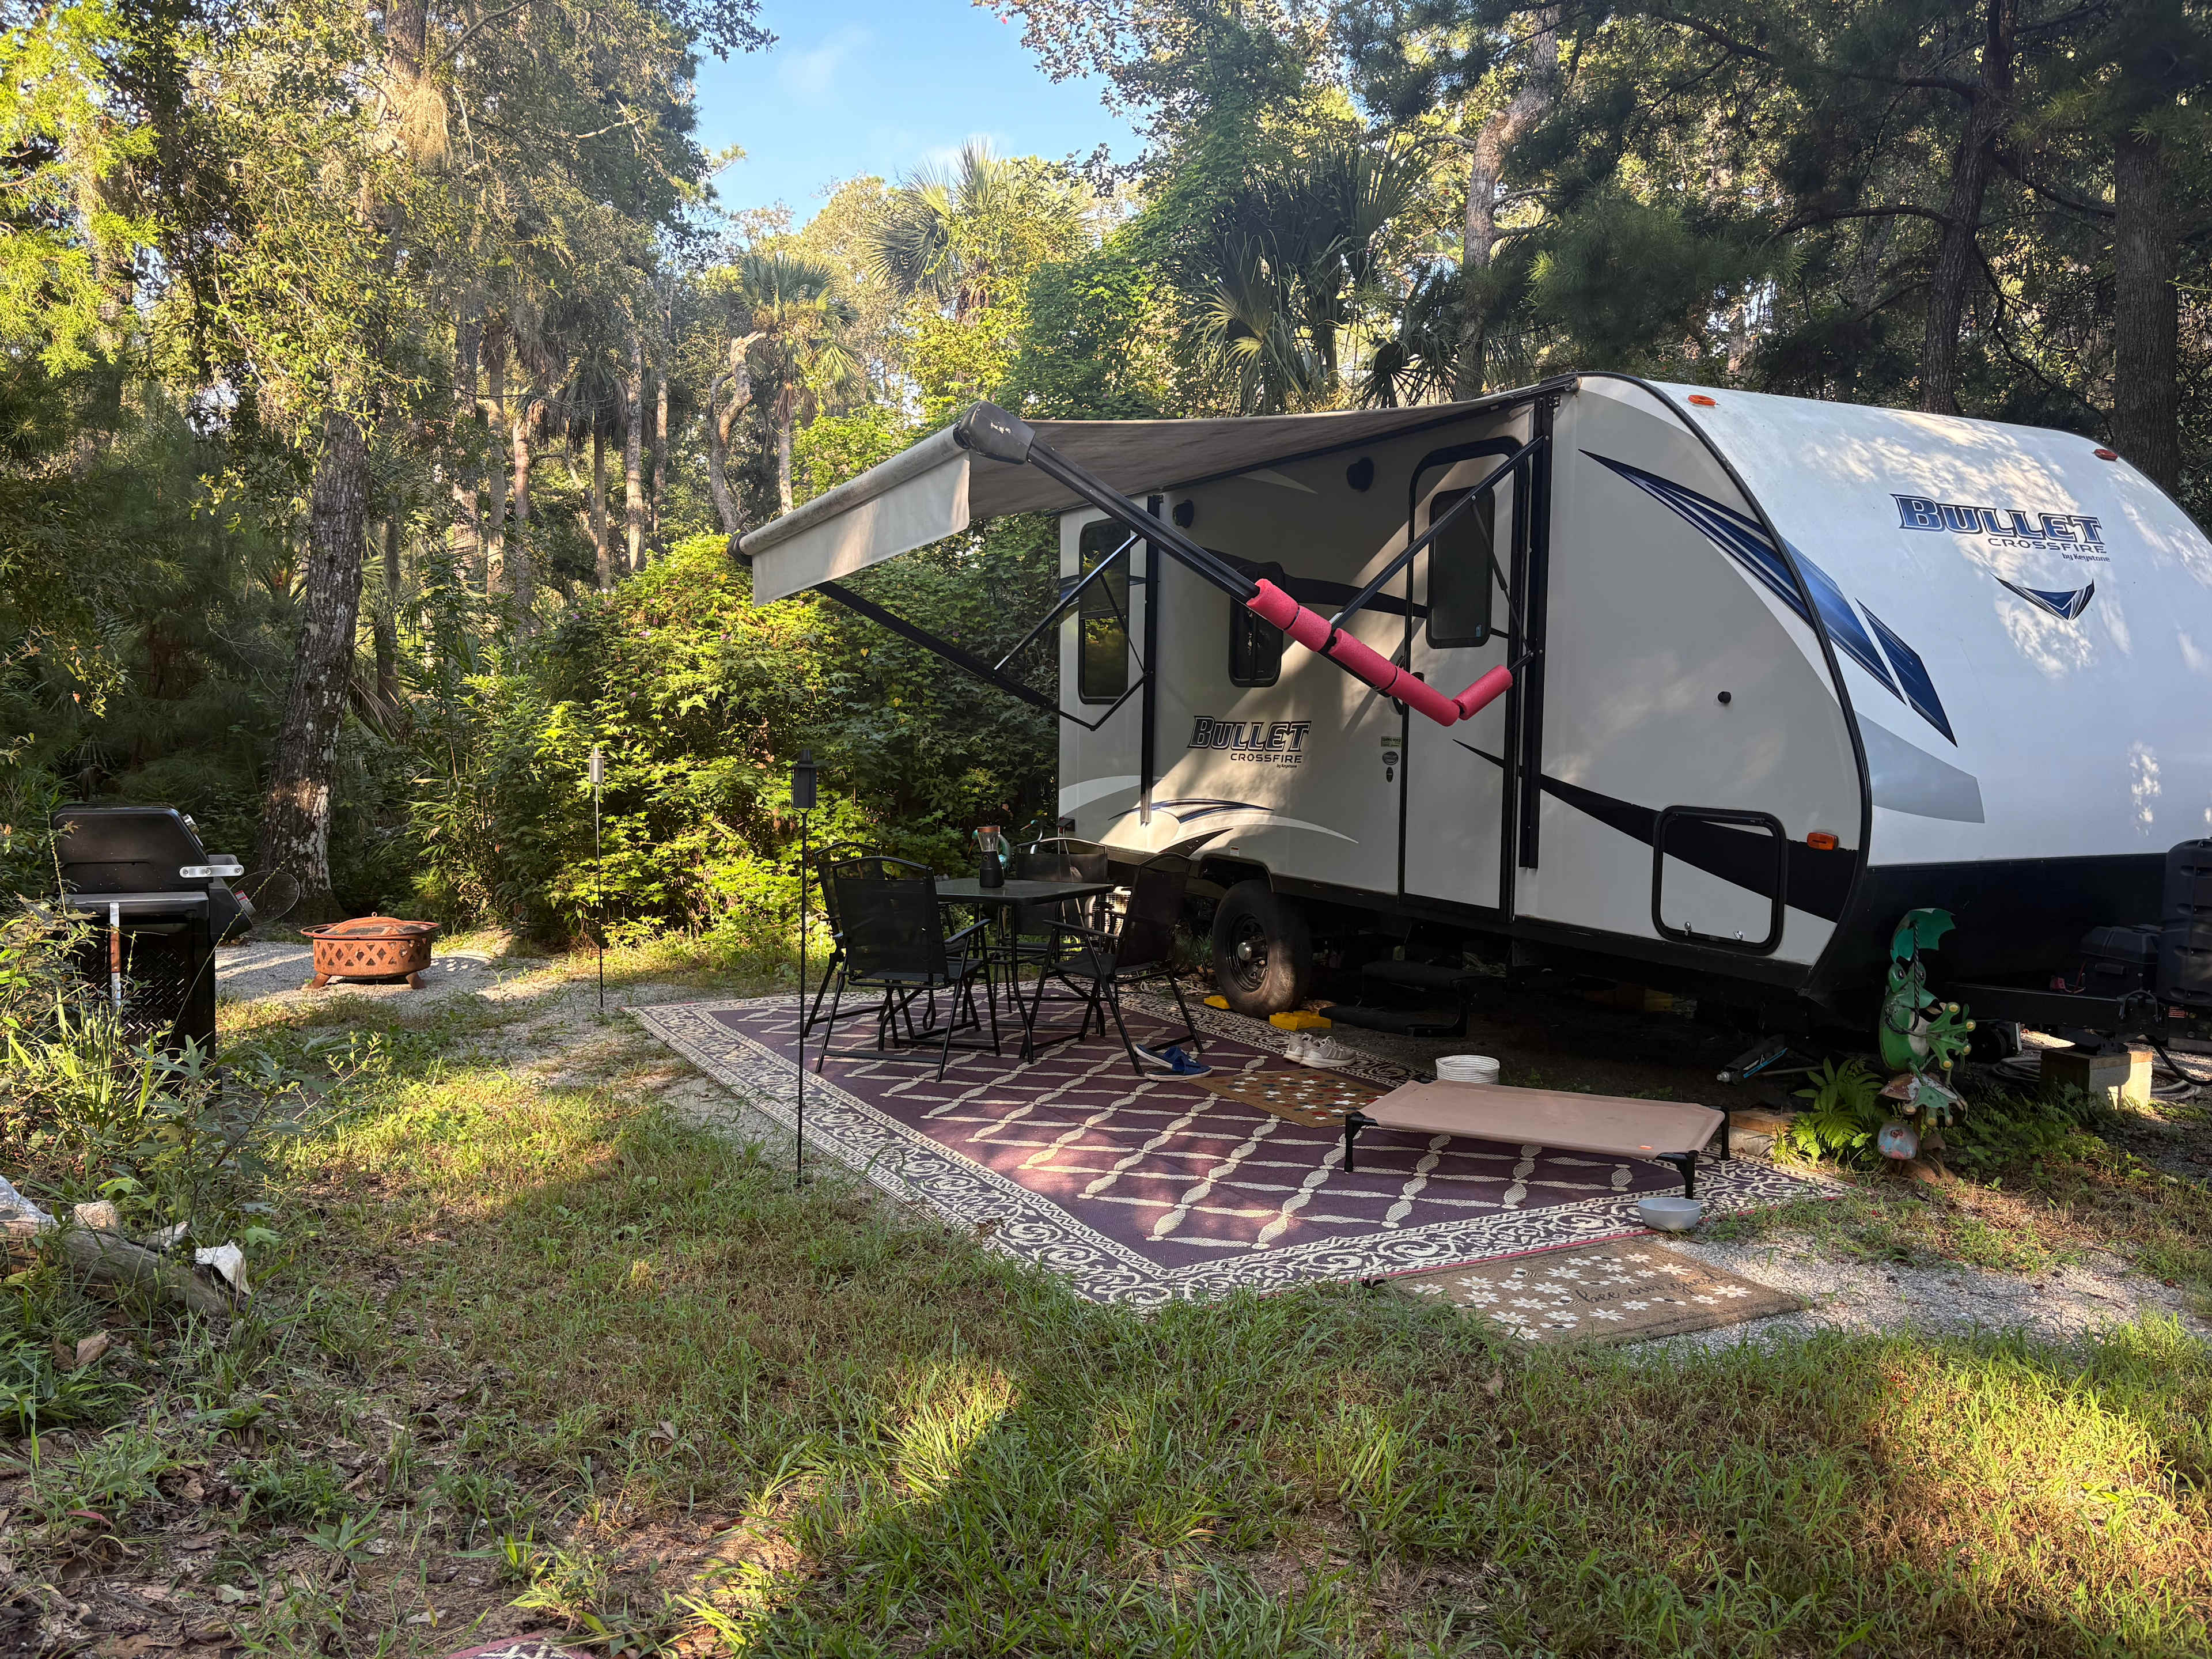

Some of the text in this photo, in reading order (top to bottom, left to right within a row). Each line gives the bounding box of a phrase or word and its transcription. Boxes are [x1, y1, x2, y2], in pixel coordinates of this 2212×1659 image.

[1889, 493, 2105, 545] BULLET
[1987, 538, 2107, 554] CROSSFIRE
[2062, 552, 2111, 562] by Keystone
[1187, 715, 1312, 752] BULLET
[1230, 753, 1302, 763] CROSSFIRE
[1575, 1270, 1722, 1303] bee our guest
